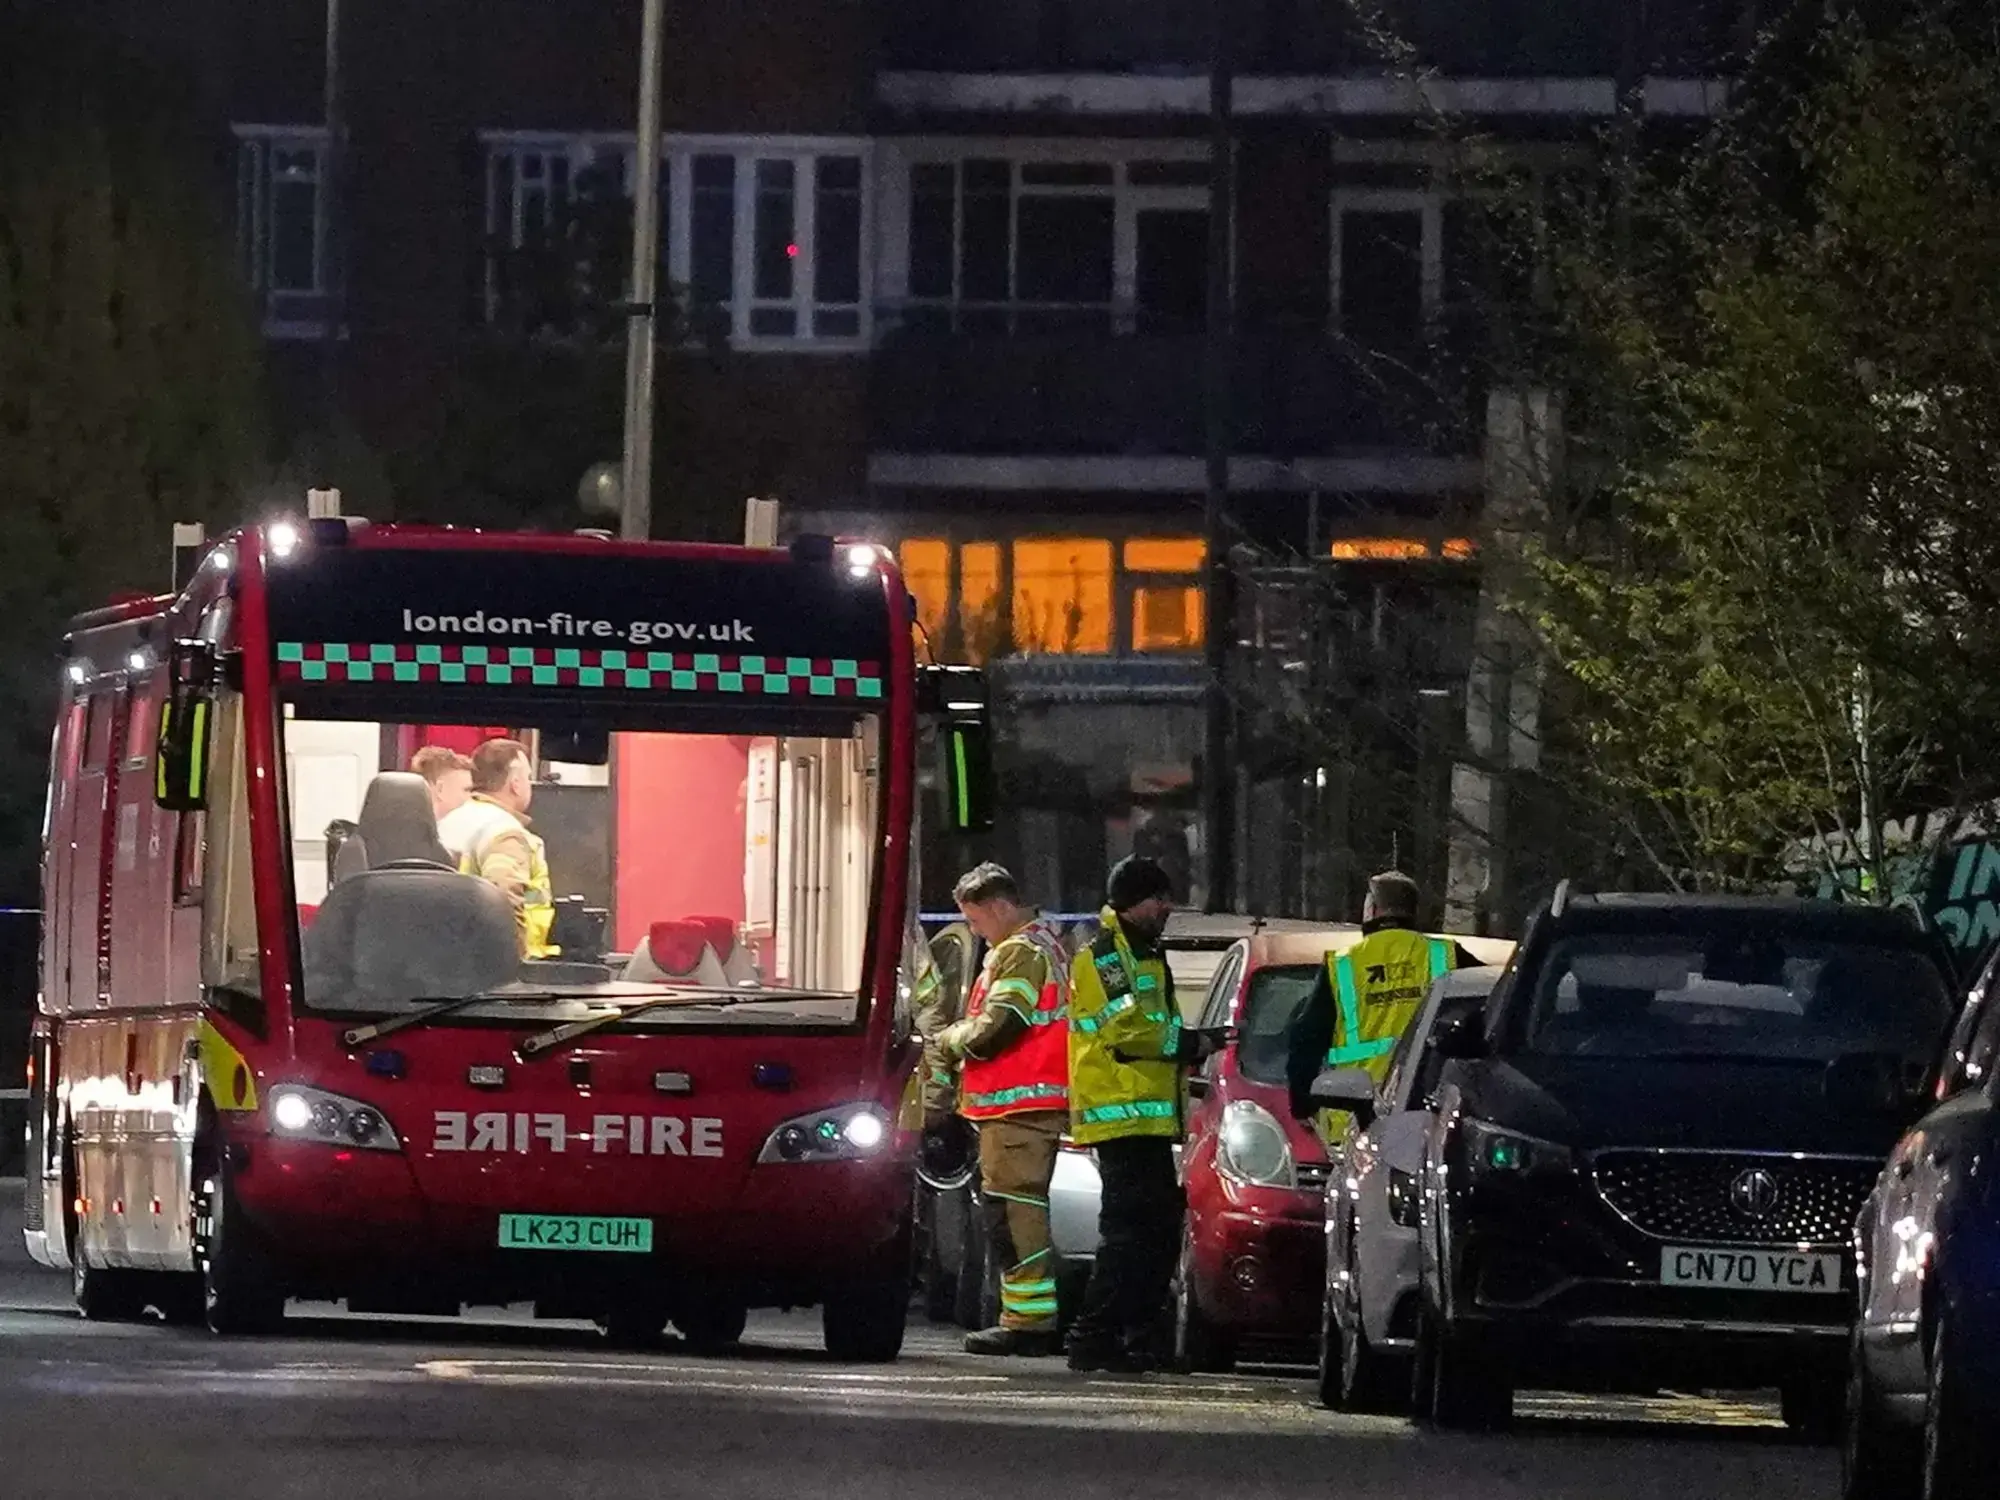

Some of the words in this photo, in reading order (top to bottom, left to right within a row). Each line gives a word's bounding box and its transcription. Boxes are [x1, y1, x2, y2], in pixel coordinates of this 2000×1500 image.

[403, 608, 755, 645] london-fire.gov.uk
[593, 1114, 724, 1158] FIRE
[510, 1218, 580, 1245] LK23
[588, 1221, 640, 1247] CUH
[1675, 1252, 1756, 1283] CN70
[1768, 1256, 1826, 1288] YCA
